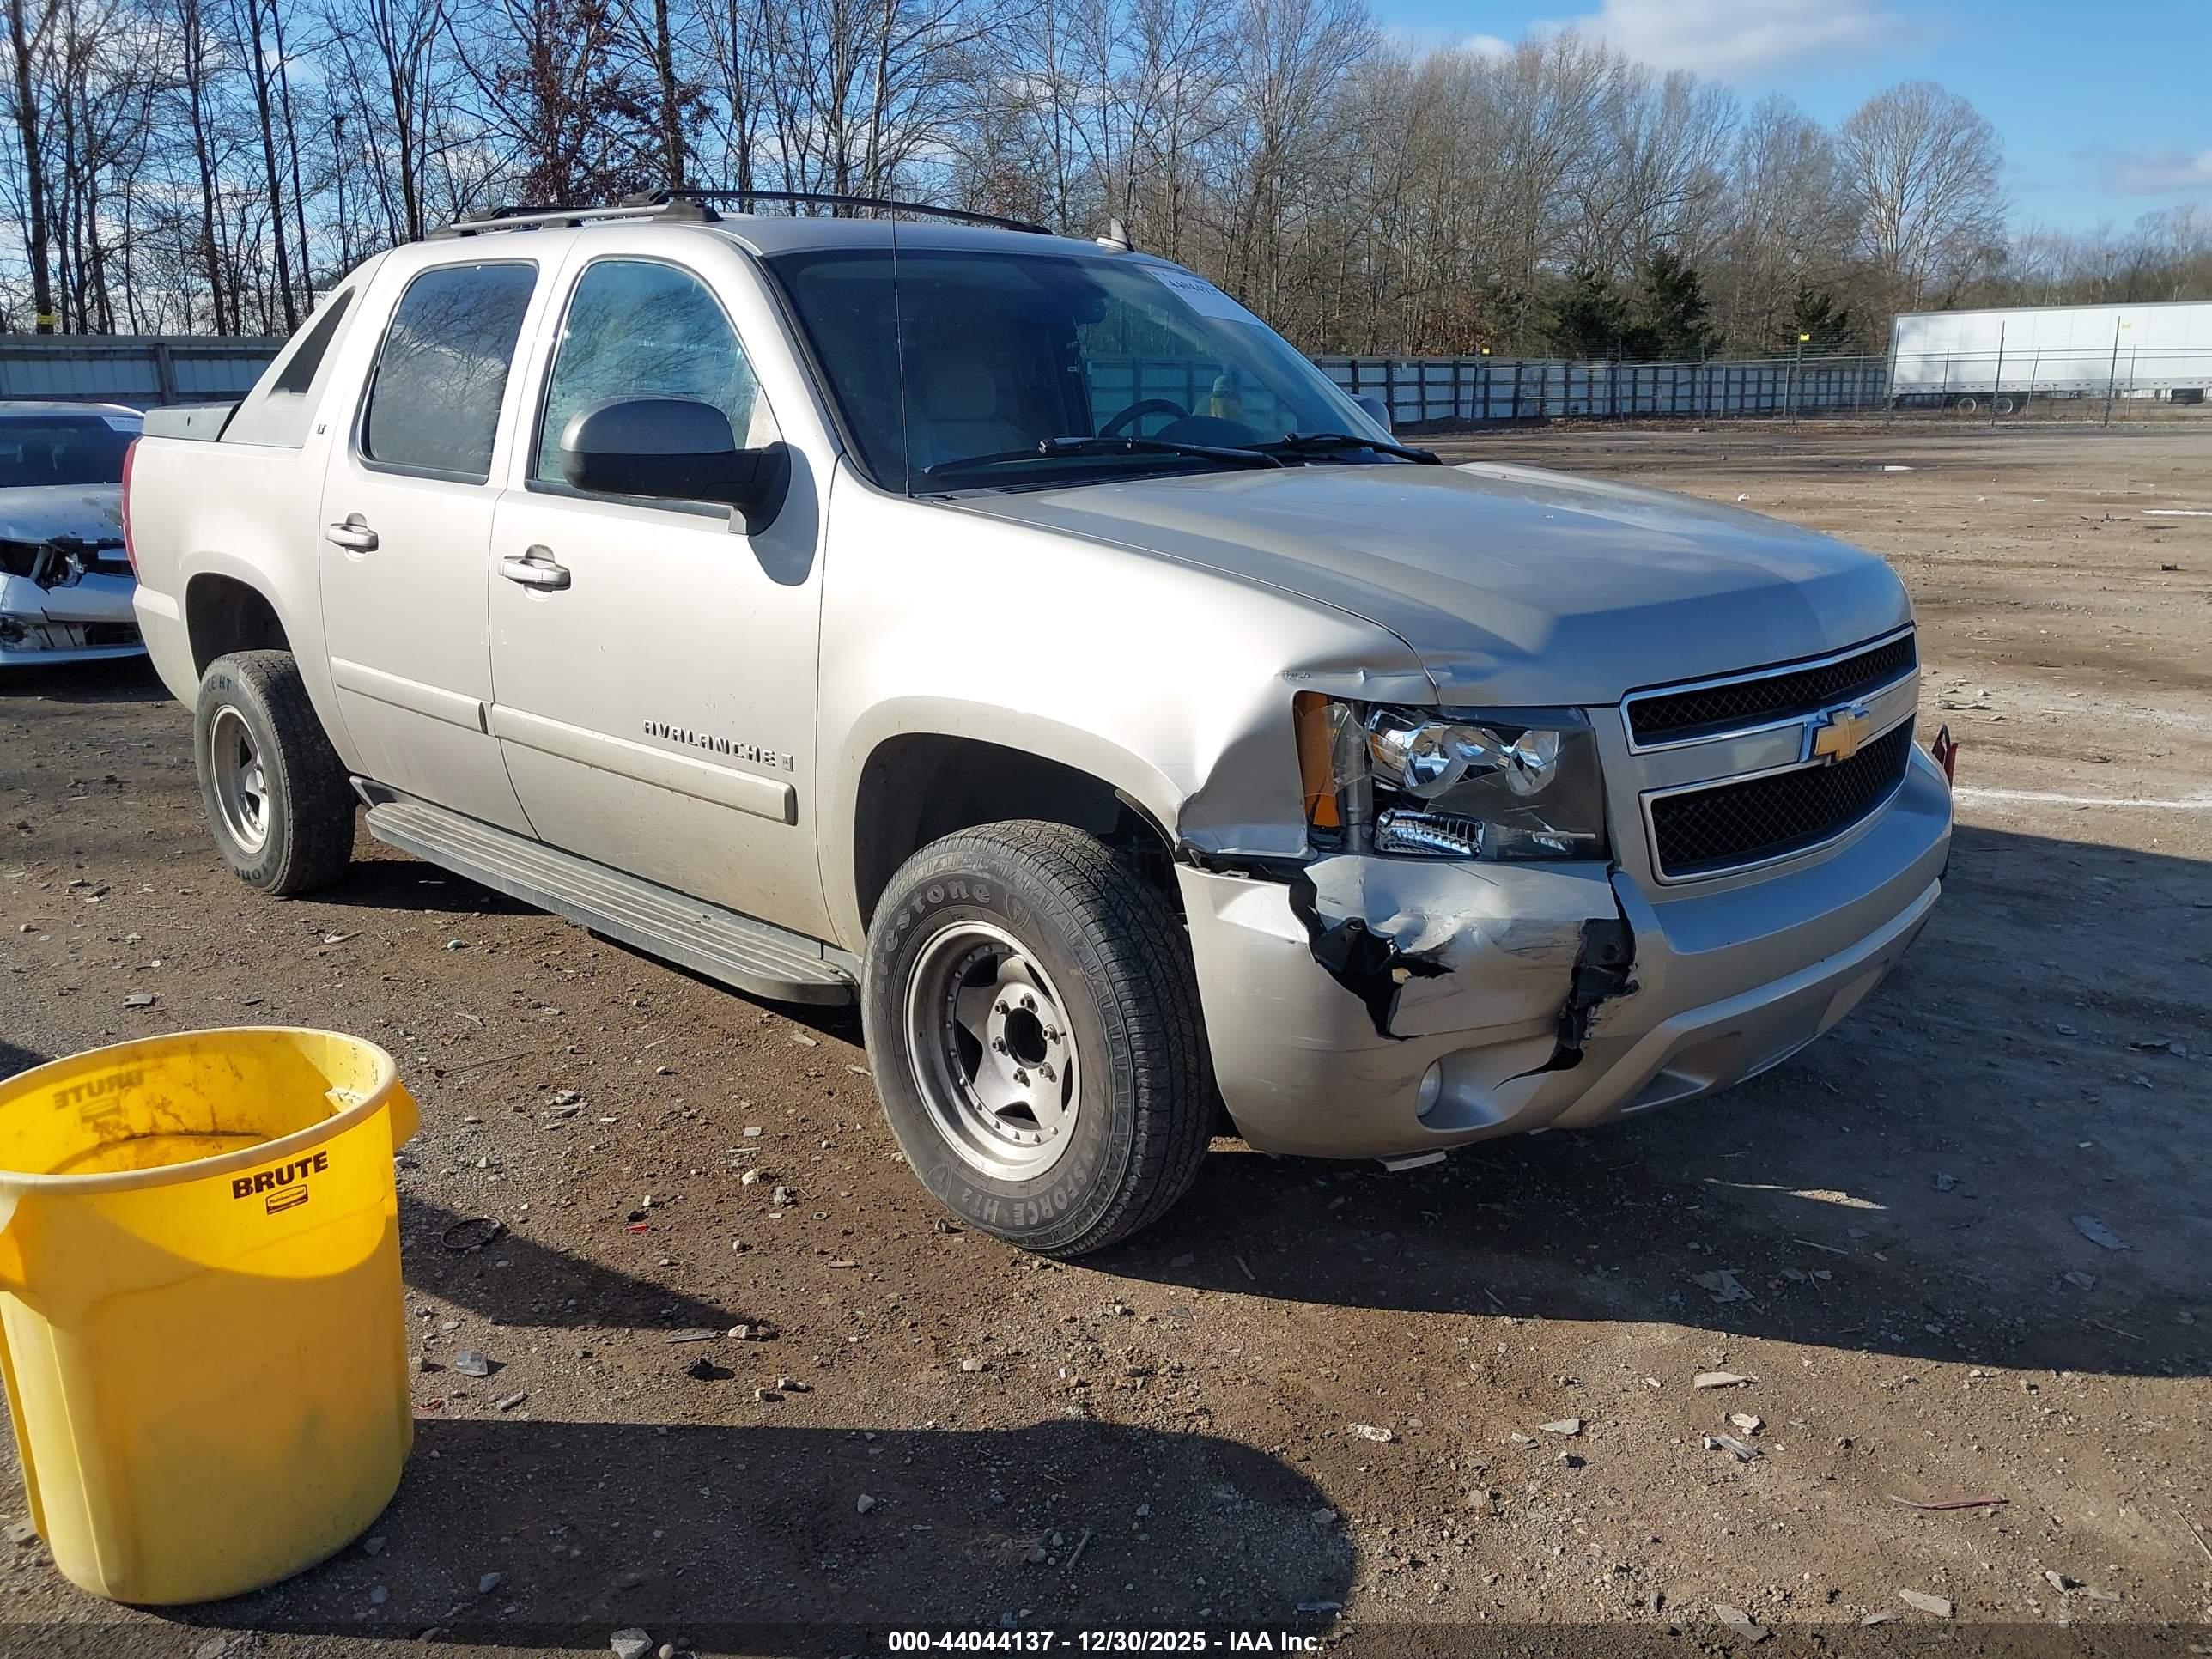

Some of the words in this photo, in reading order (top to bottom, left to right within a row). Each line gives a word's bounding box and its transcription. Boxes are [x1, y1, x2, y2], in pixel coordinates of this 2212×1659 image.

[317, 423, 328, 434] LT
[643, 720, 776, 767] AVALANCHE
[231, 1149, 329, 1200] BRUTE
